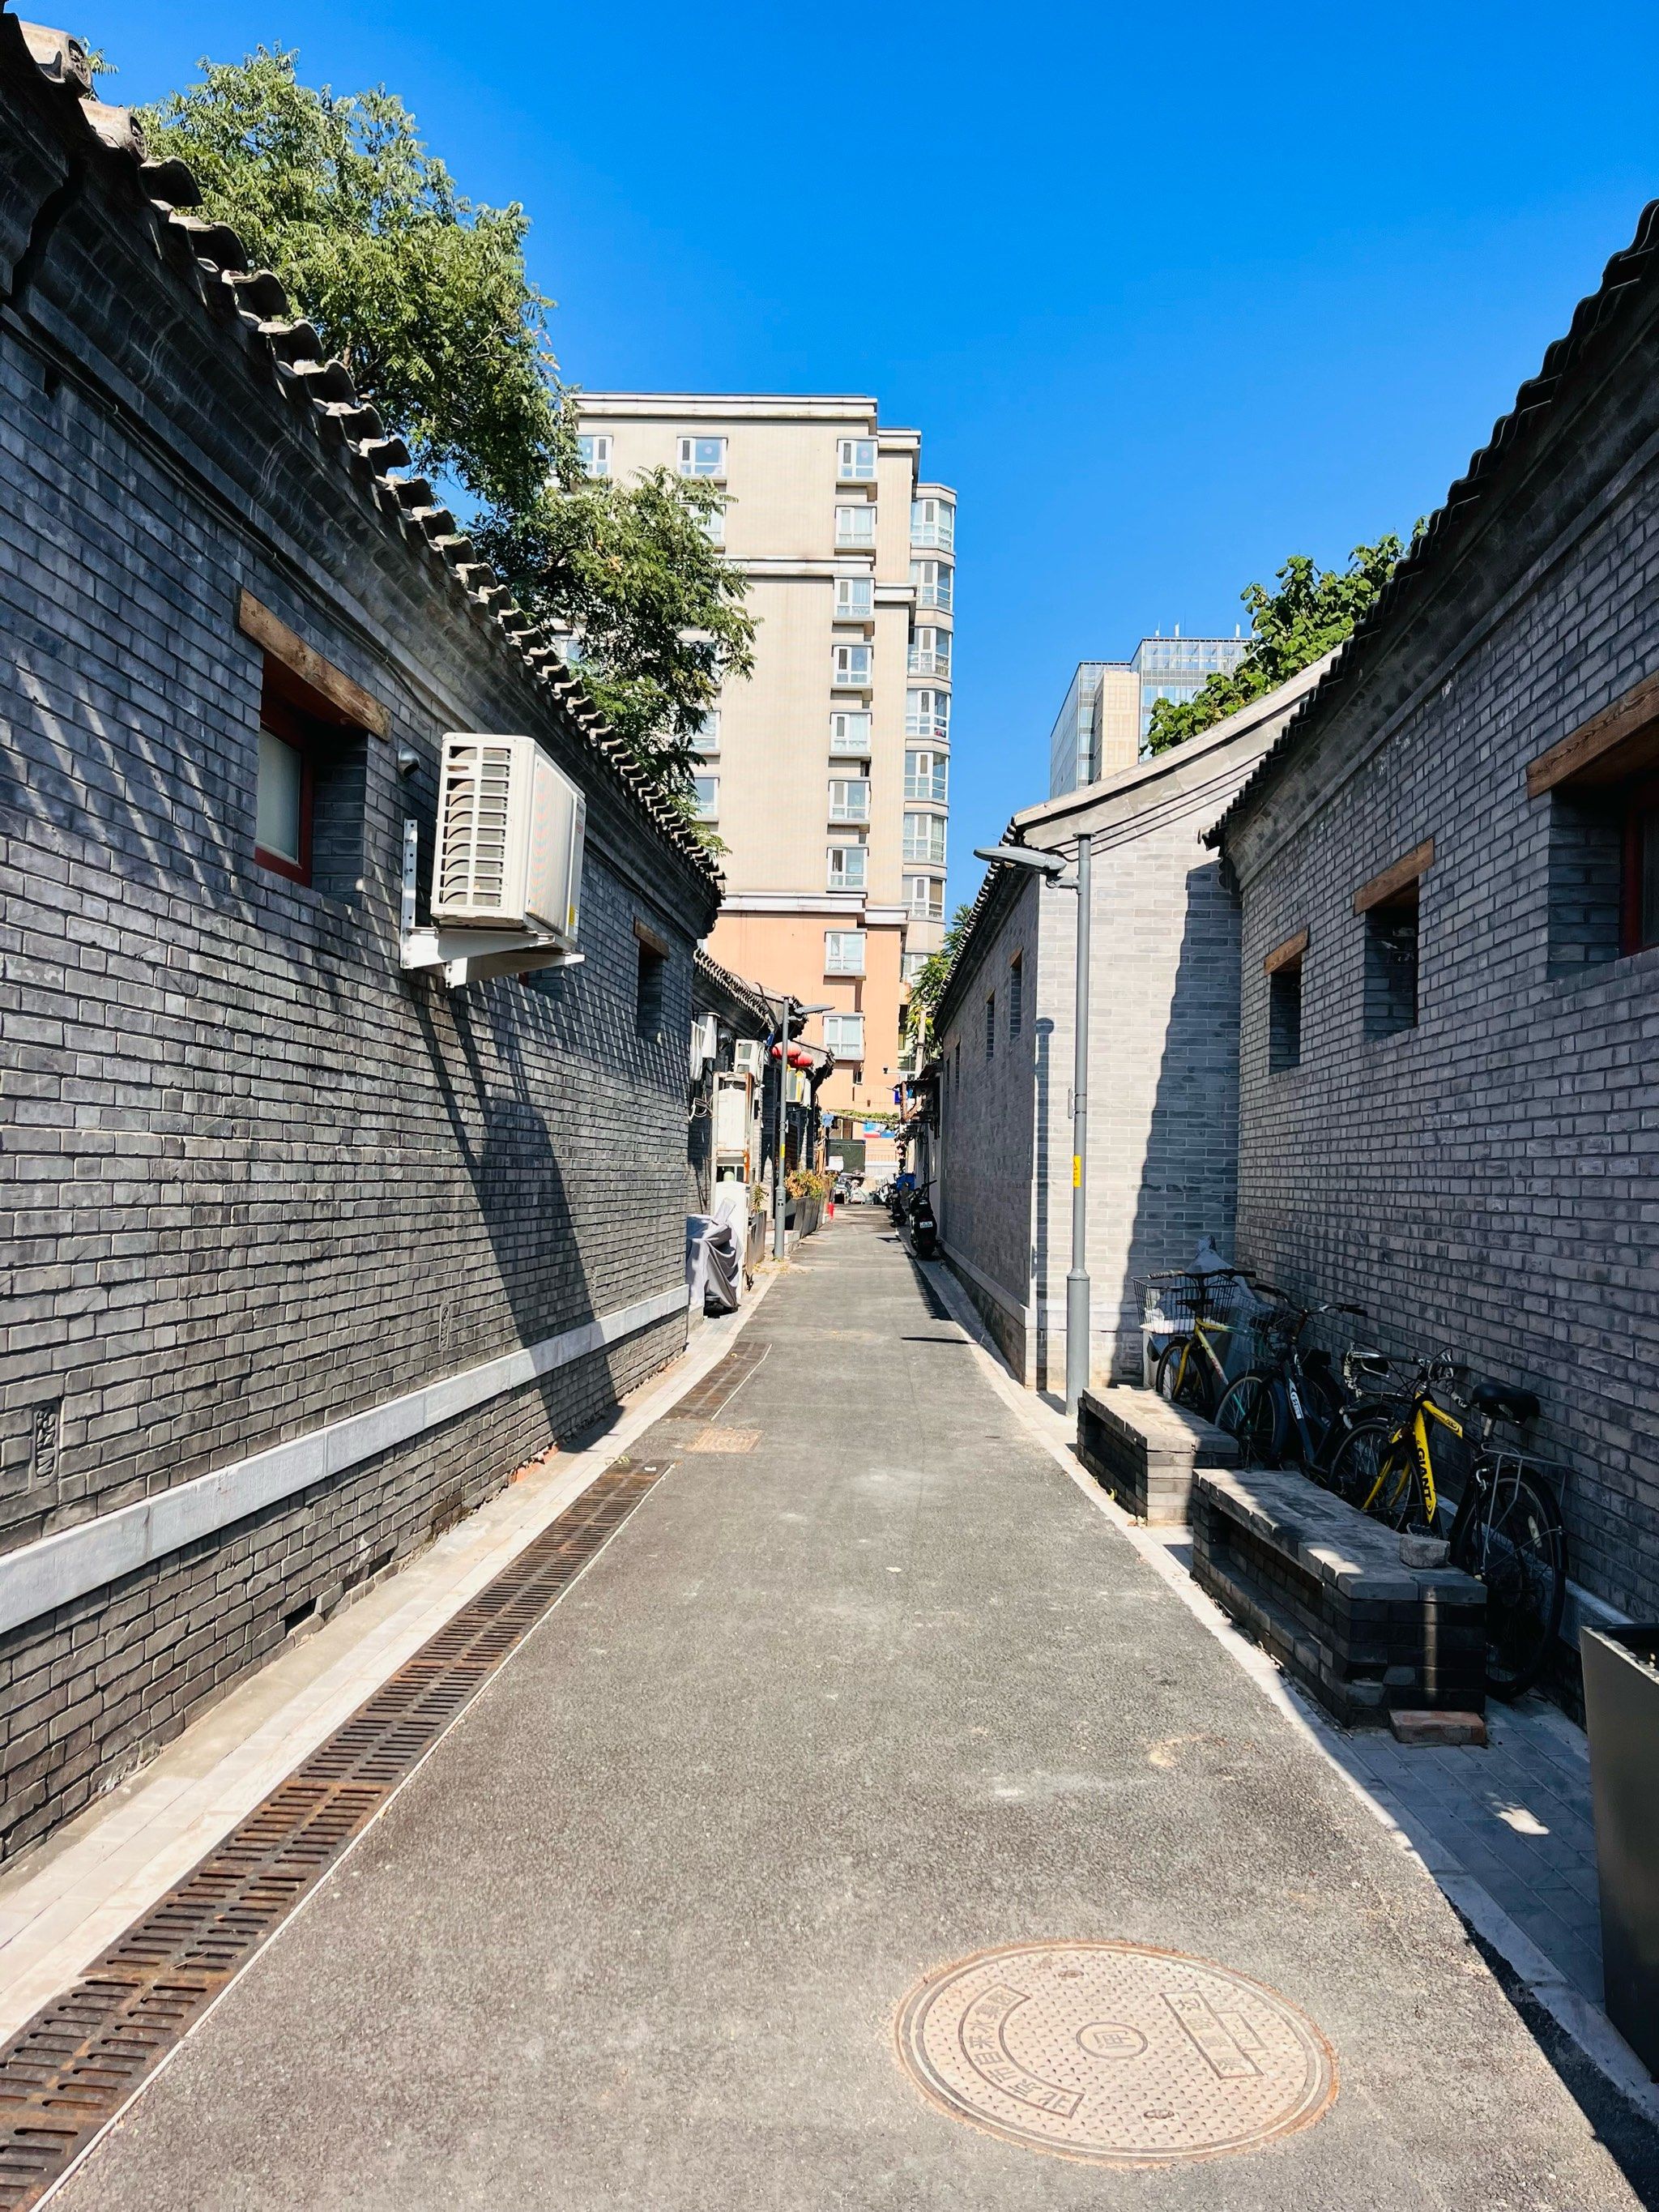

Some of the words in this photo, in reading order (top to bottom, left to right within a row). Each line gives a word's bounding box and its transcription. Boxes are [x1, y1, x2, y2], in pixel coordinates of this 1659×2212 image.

[1418, 1448, 1432, 1501] GIANT
[968, 1988, 1069, 2110] 北京市自来水集团
[1093, 2030, 1136, 2049] 闸
